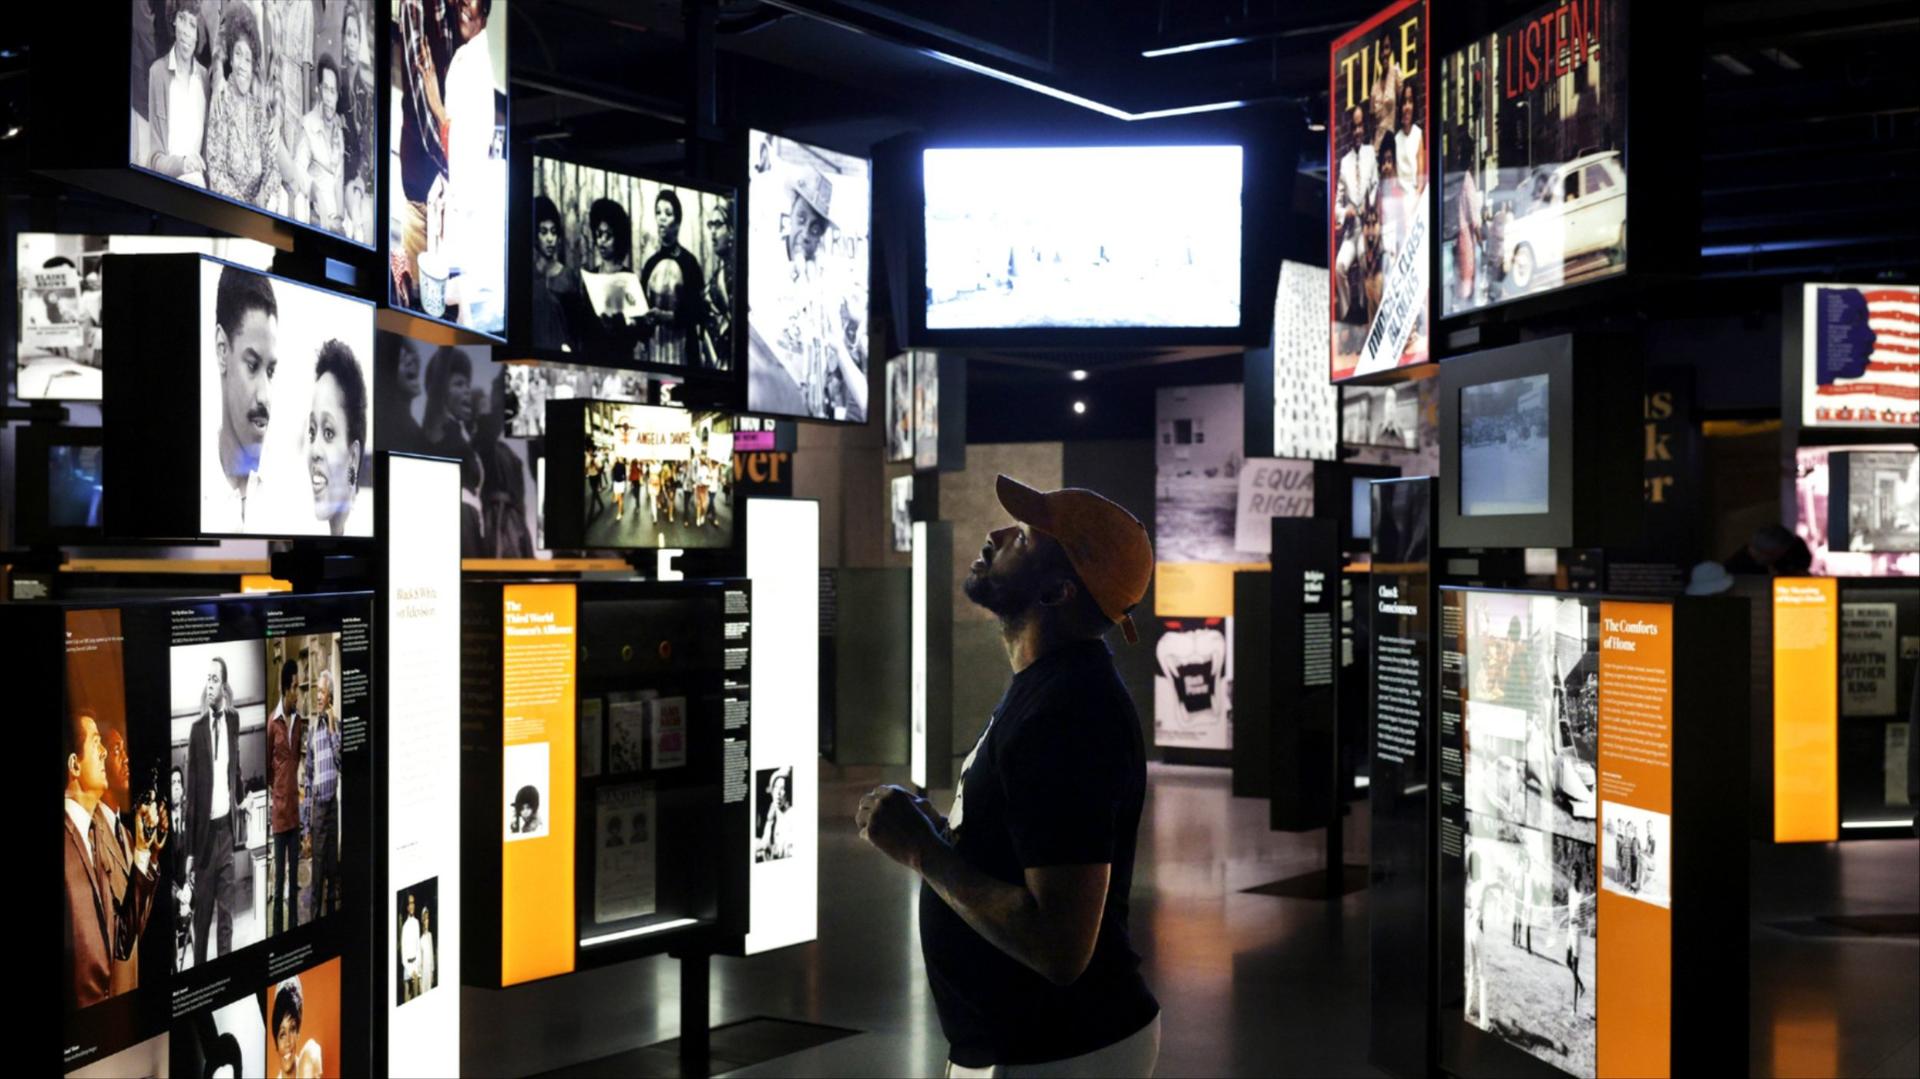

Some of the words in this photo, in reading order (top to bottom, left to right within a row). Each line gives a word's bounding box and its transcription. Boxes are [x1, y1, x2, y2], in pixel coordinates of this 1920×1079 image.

[1507, 0, 1599, 98] LISTEN!
[637, 432, 666, 445] ANGELA
[505, 600, 521, 612] The
[505, 613, 529, 624] Third
[529, 612, 554, 623] World
[1604, 618, 1618, 632] The
[1619, 620, 1659, 635] Comforts
[1603, 636, 1612, 649] of
[1612, 638, 1636, 651] Home
